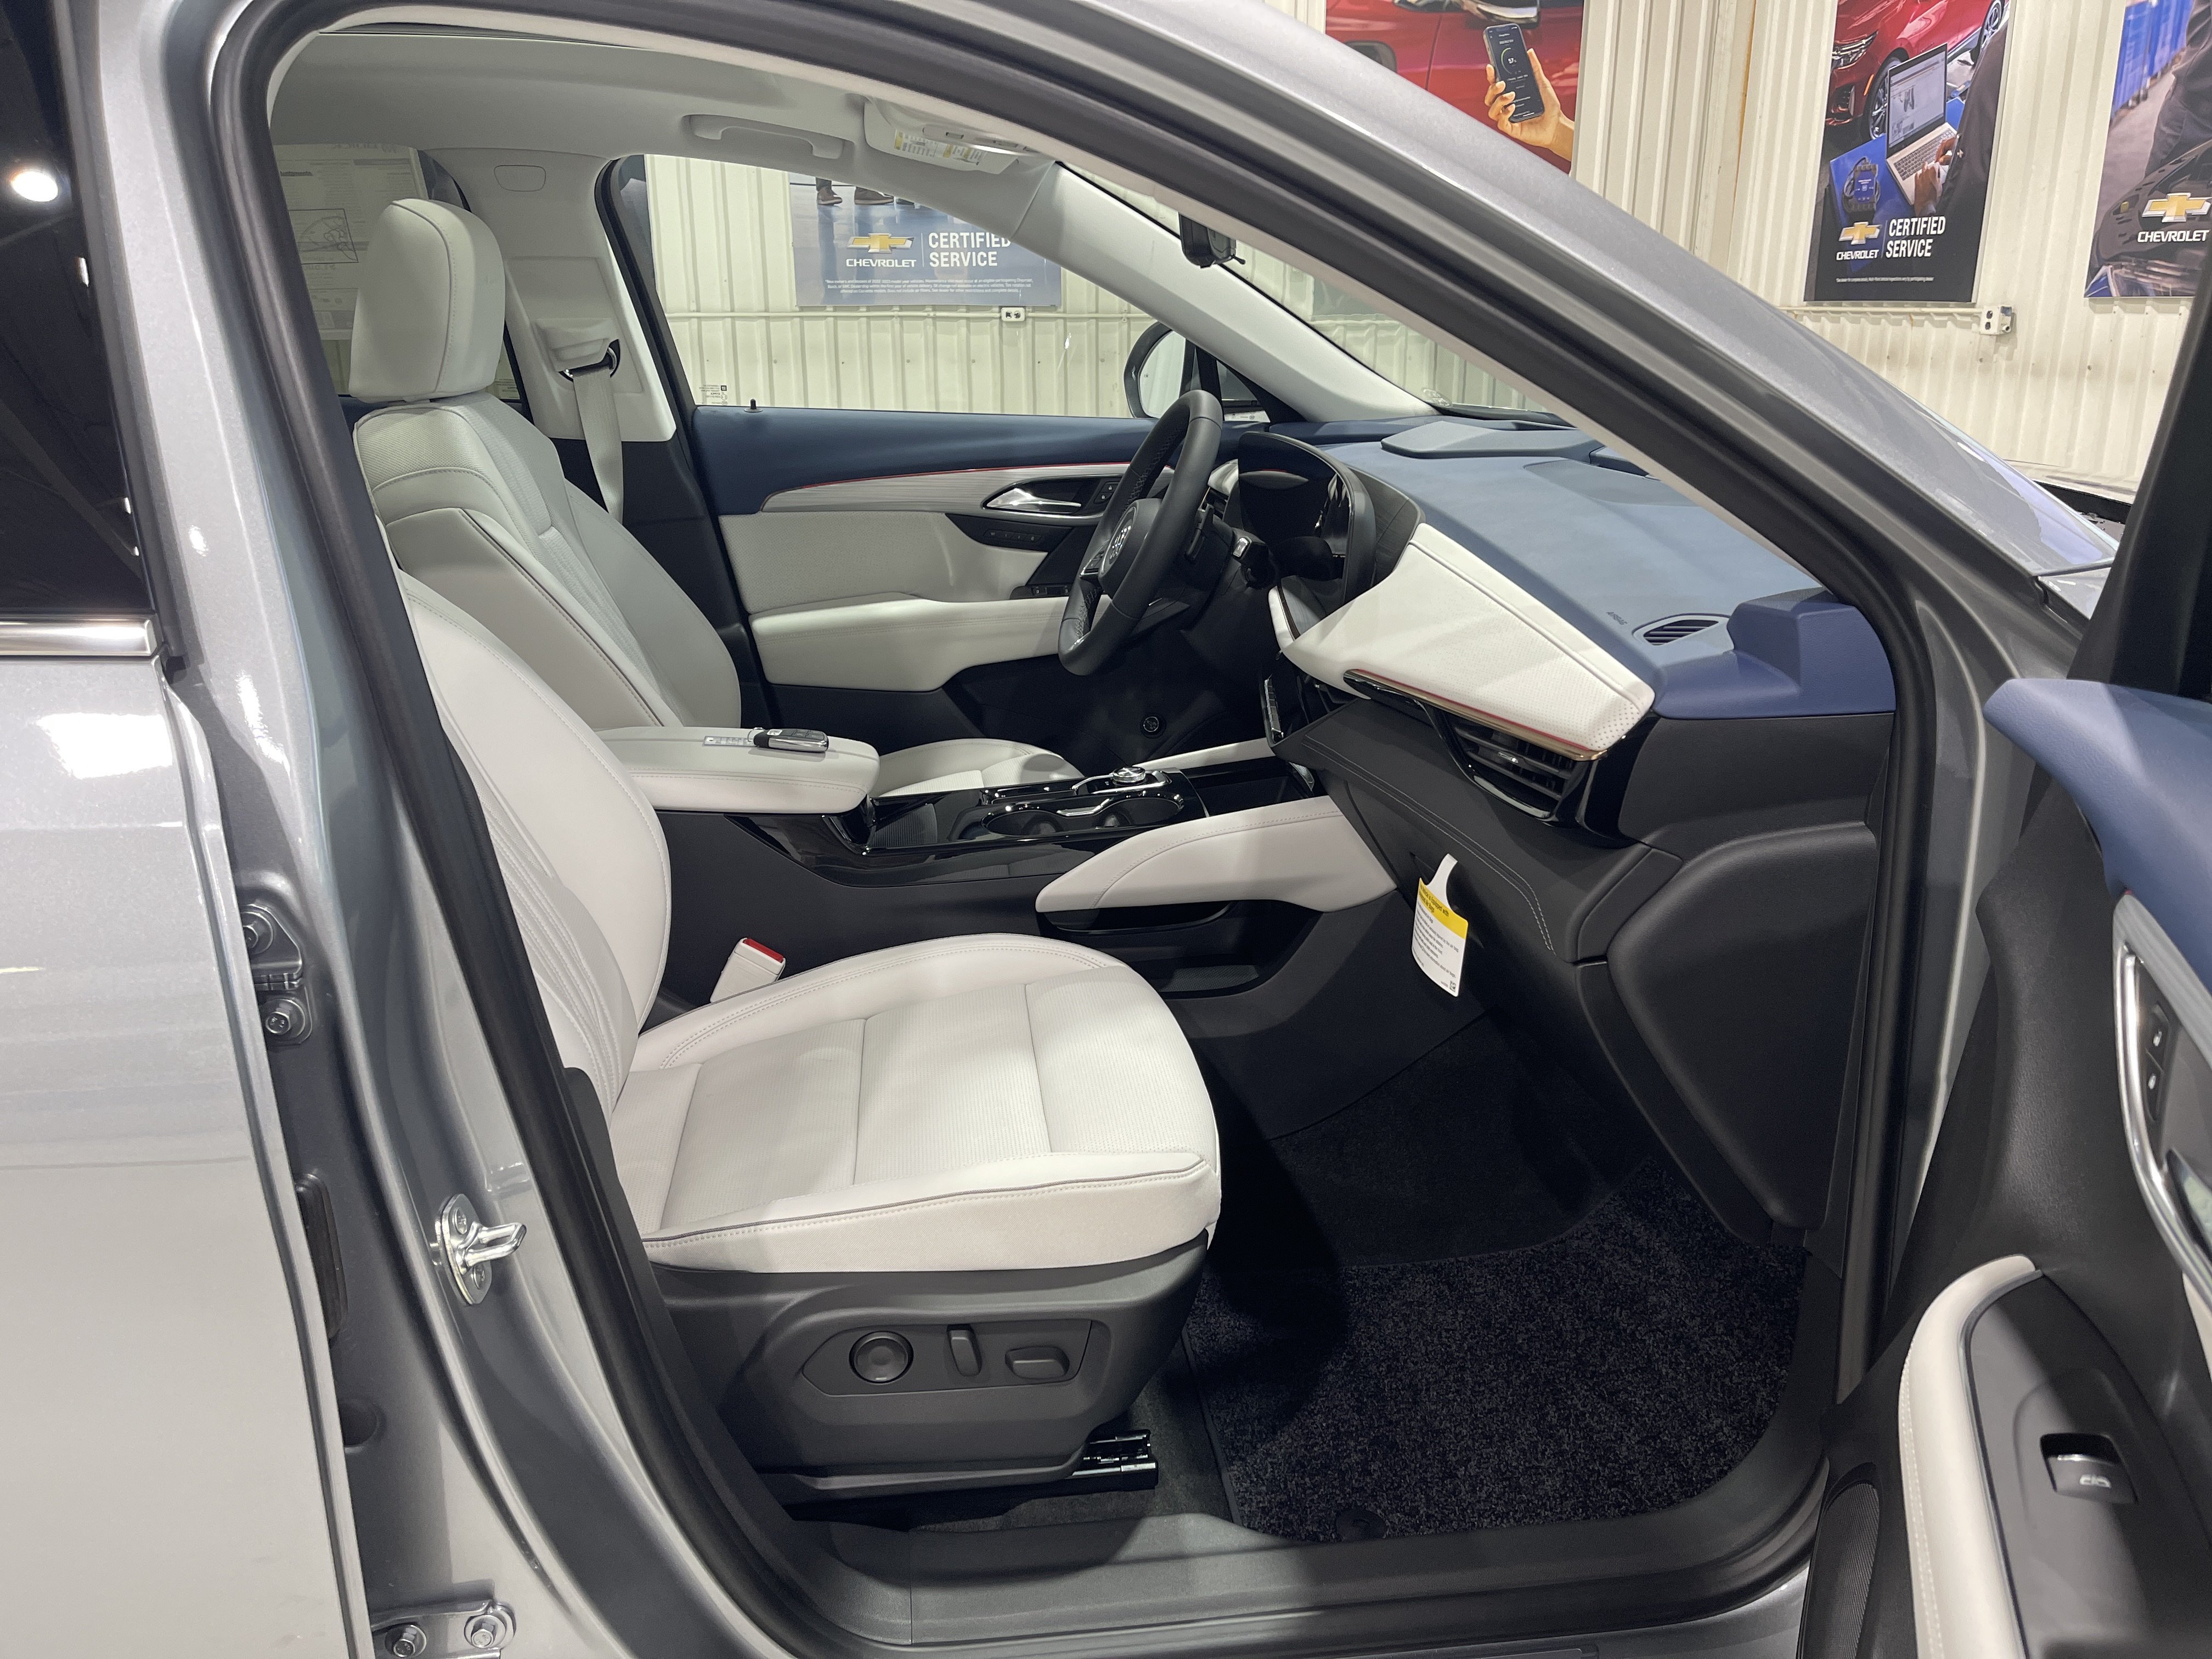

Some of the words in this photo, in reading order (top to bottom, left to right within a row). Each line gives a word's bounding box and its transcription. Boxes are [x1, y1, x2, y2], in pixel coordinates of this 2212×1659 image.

[1888, 216, 1946, 237] CERTIFIED
[928, 232, 1012, 249] CERTIFIED
[2137, 229, 2210, 243] CHEVROLET
[1836, 249, 1880, 261] CHEVROLET
[1885, 239, 1934, 258] SERVICE
[845, 258, 917, 268] CHEVROLET
[929, 251, 998, 267] SERVICE
[1606, 612, 1628, 625] AIRBAG
